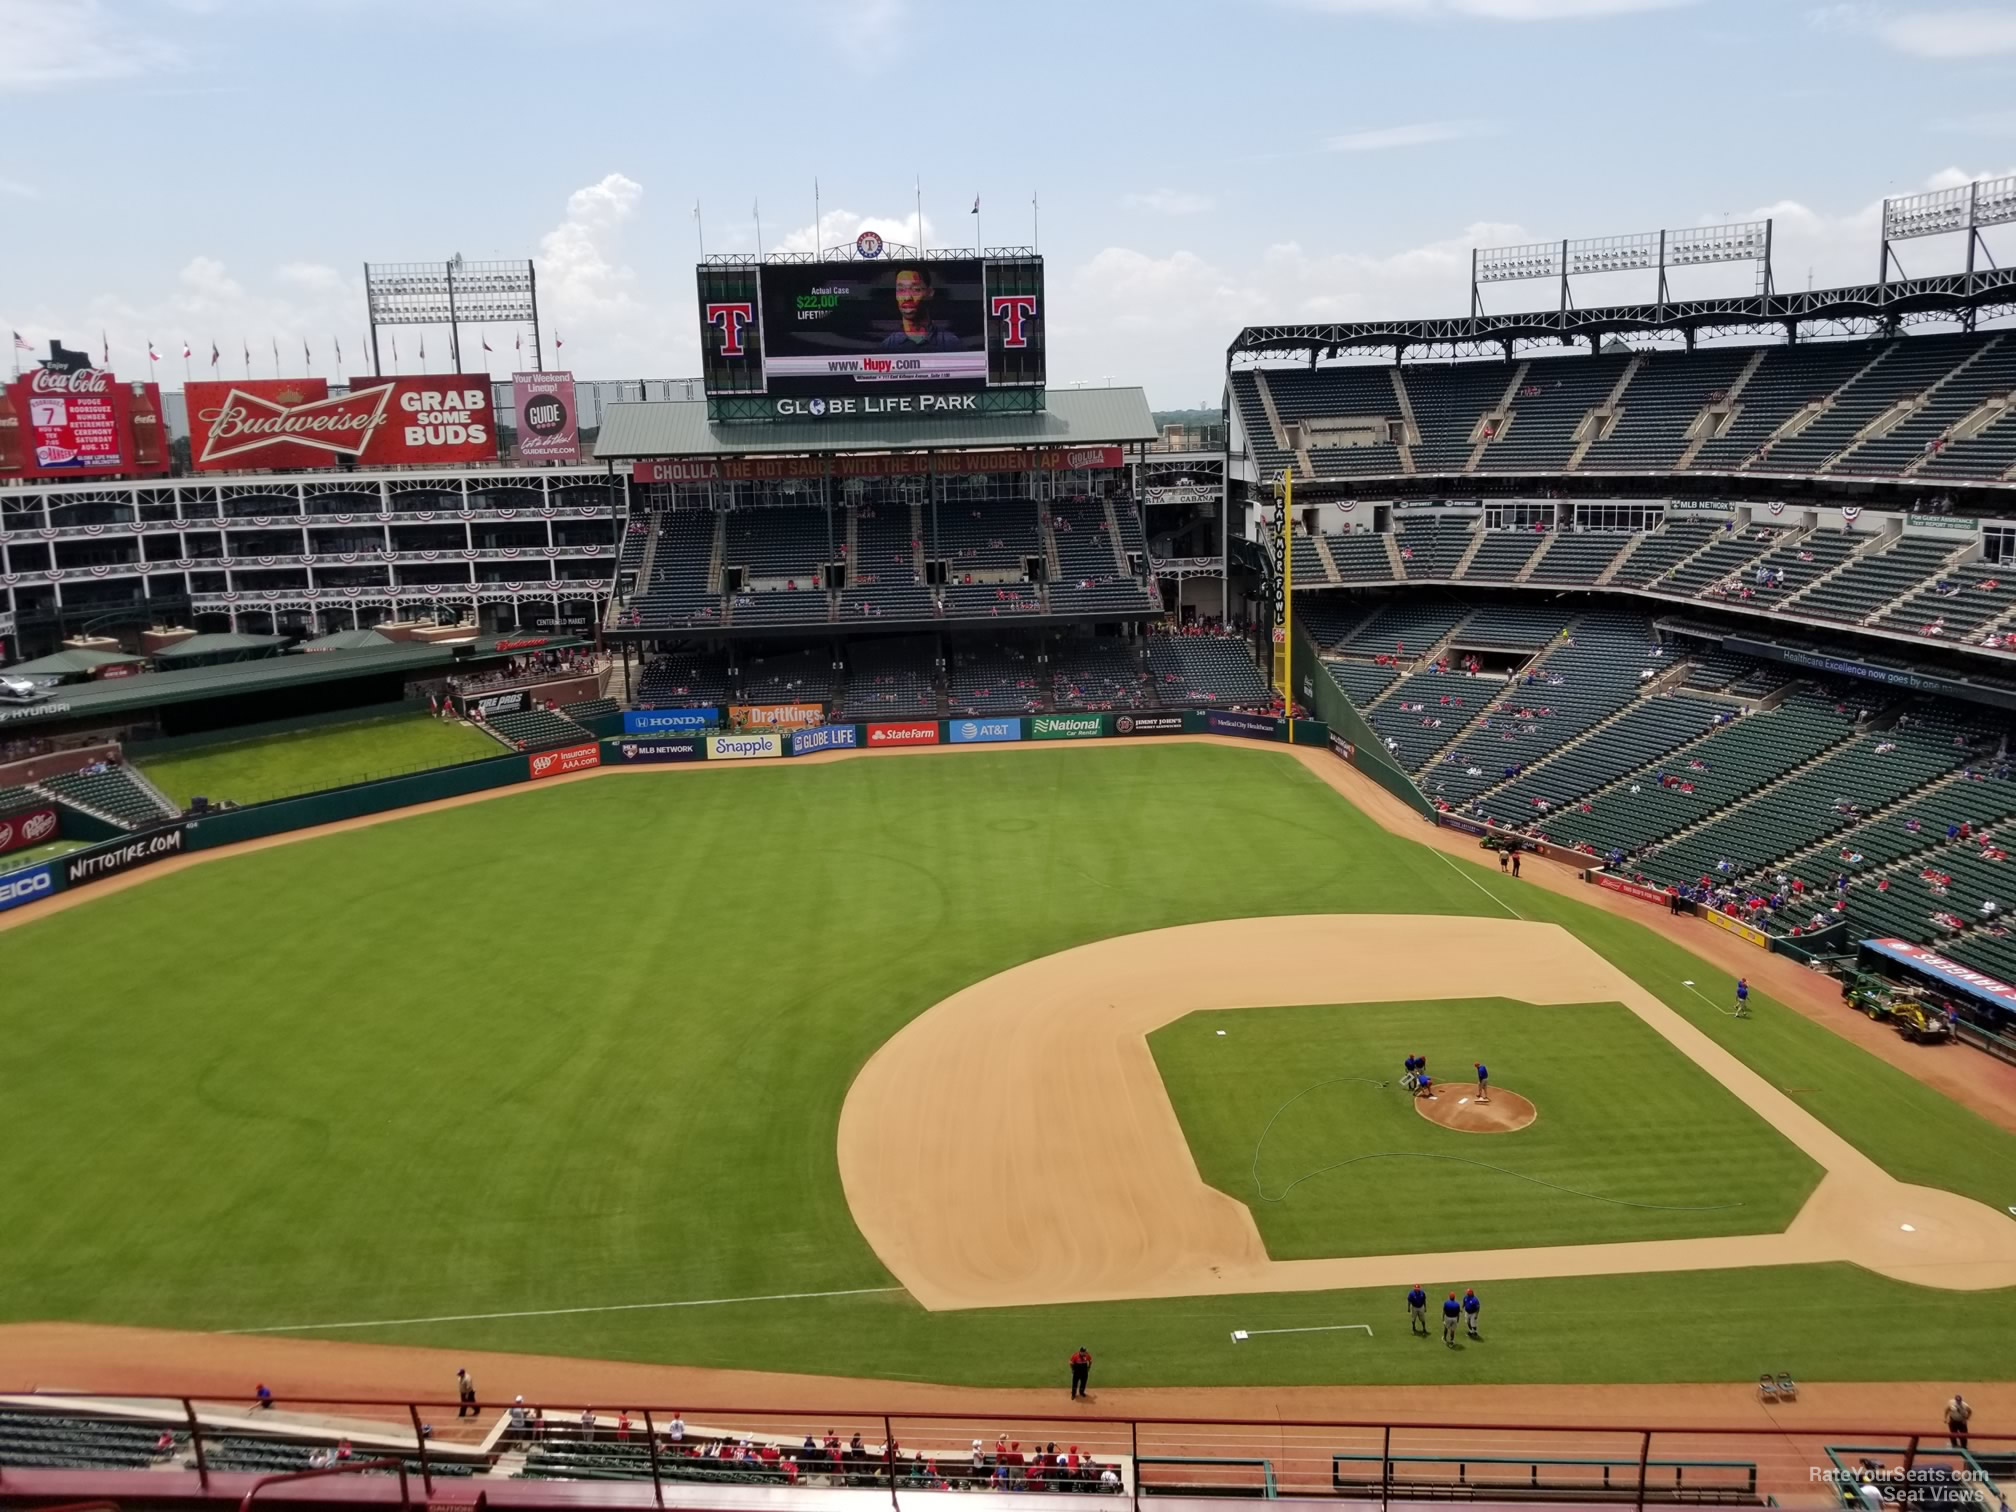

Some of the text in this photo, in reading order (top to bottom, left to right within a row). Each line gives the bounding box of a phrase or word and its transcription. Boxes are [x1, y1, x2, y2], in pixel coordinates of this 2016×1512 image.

[811, 286, 850, 295] Actual Case
[797, 310, 833, 320] LIFETIM
[991, 295, 1036, 348] T
[706, 302, 752, 356] T
[47, 362, 69, 370] Enjoy
[828, 357, 921, 373] www.Hupy.com
[513, 373, 570, 383] Your Weekend
[527, 383, 558, 394] Lineup!
[400, 389, 486, 412] GRAB
[777, 394, 977, 416] GLOBE LIFE PARK
[42, 407, 54, 425] 7
[198, 406, 389, 439] Budweiser
[417, 411, 472, 425] SOME
[529, 404, 560, 425] GUIDE
[404, 425, 487, 446] BUDS
[522, 447, 575, 455] GUIDELIVE.COM
[1067, 449, 1104, 465] CHOLULA
[653, 462, 719, 480] CHOLULA
[723, 462, 750, 478] THE
[757, 461, 784, 477] HOT
[842, 458, 878, 474] WITH
[882, 457, 910, 473] THE
[966, 454, 1027, 470] WOODEN
[1180, 495, 1214, 503] CABANA
[1698, 501, 1729, 510] NETWORK
[1275, 498, 1284, 532] EAT
[1275, 538, 1285, 573] MOR
[1275, 578, 1285, 625] FOWL
[536, 617, 586, 627] CENTERELD MARKET
[1783, 650, 1824, 667] Healthcare
[1825, 659, 1867, 676] Excellence
[1868, 669, 1886, 680] now
[1887, 672, 1909, 685] goes
[1910, 675, 1921, 688] by
[1922, 680, 1941, 689] one
[497, 693, 523, 710] PROS
[12, 703, 71, 718] HYUNDAI
[752, 707, 821, 724] DraftKings
[650, 716, 705, 726] HONDA
[1048, 718, 1100, 731] National
[1218, 719, 1275, 732] Medical City Healthcare
[980, 724, 1009, 736] AT&T
[716, 738, 774, 756] Snapple
[803, 733, 829, 749] GLOBE
[832, 730, 854, 744] LIFE
[560, 747, 597, 760] Insurance
[656, 745, 693, 753] NETWORK
[562, 756, 598, 770] AAA.com
[70, 830, 181, 881] NITTOTIRE.COM
[0, 872, 51, 901] EICO
[1913, 953, 2009, 992] RANGERS
